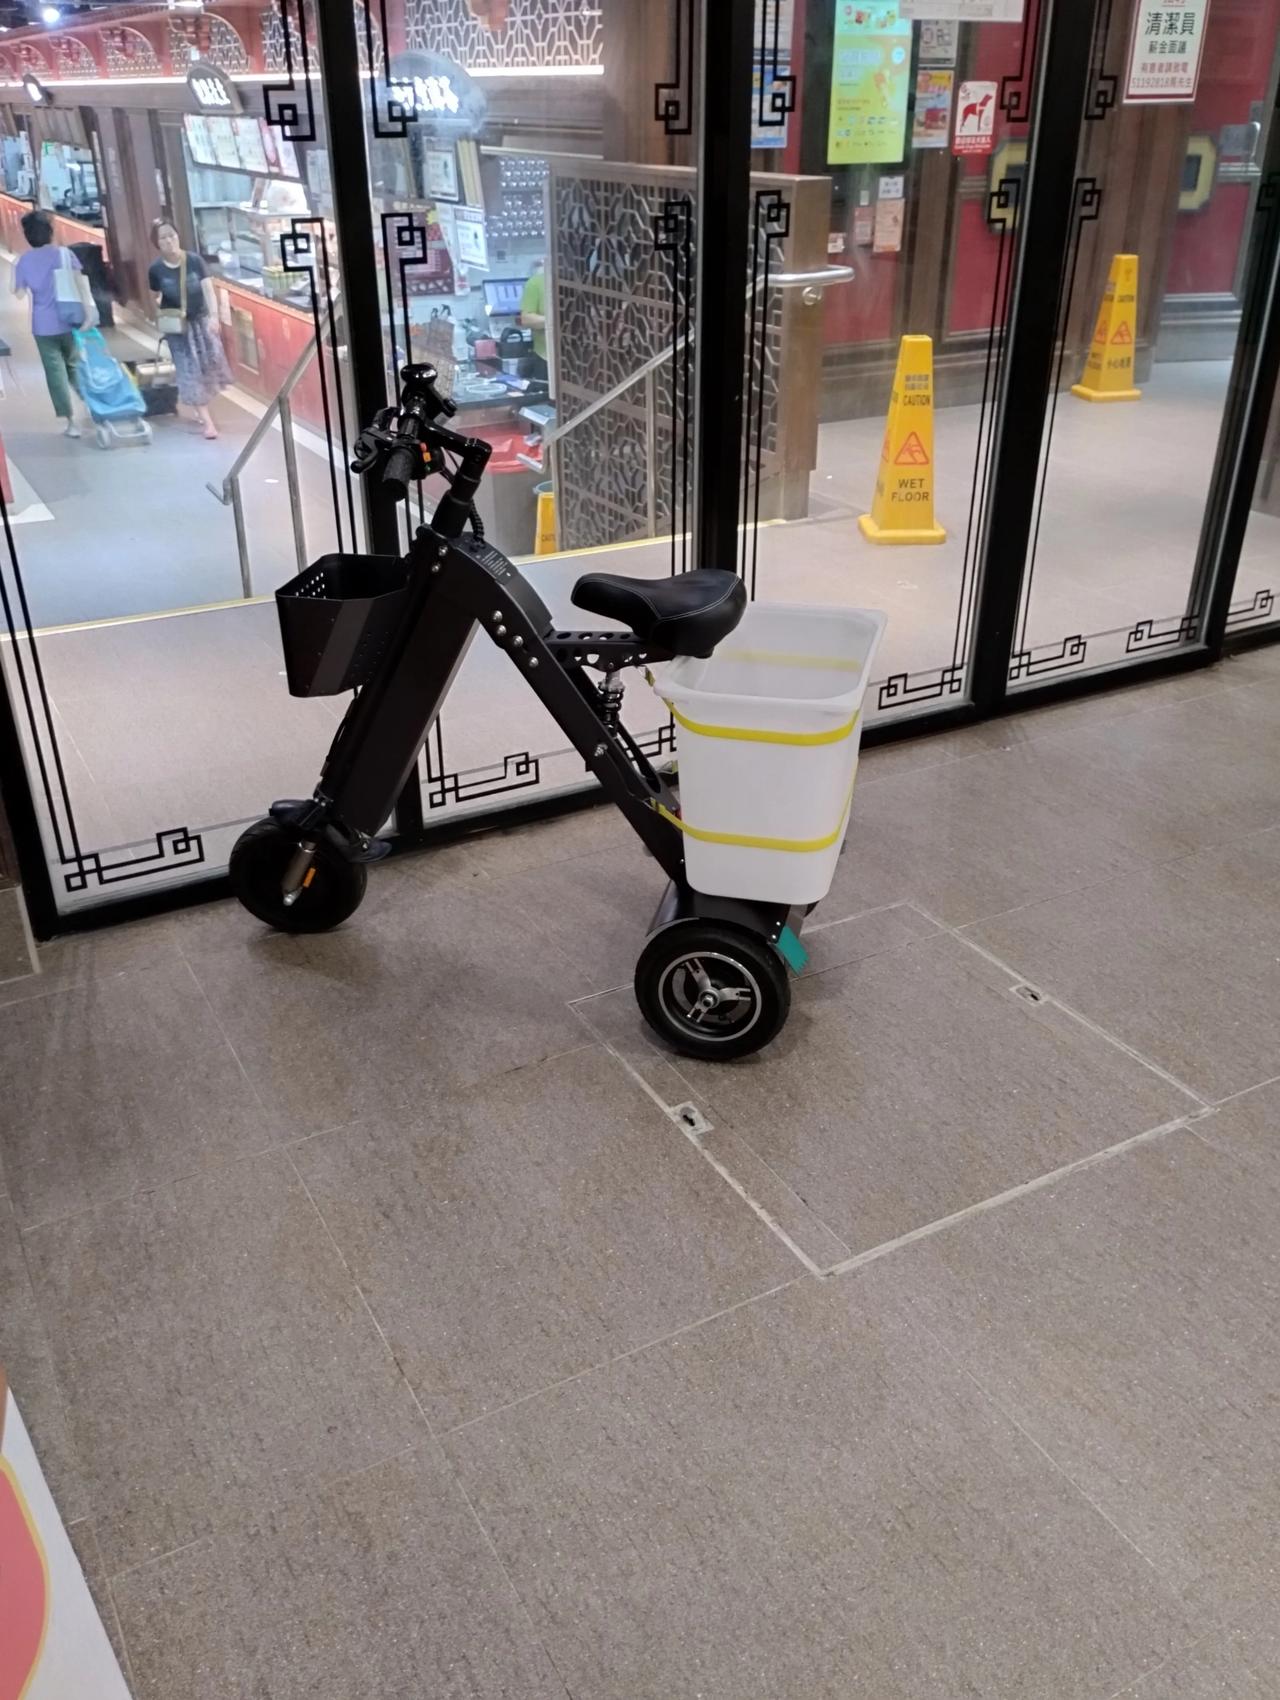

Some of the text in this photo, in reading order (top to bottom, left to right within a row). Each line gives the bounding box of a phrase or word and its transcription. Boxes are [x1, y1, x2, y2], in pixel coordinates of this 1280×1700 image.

[1145, 11, 1196, 35] 清潔員
[898, 478, 925, 489] WET
[891, 491, 930, 502] FLOOR
